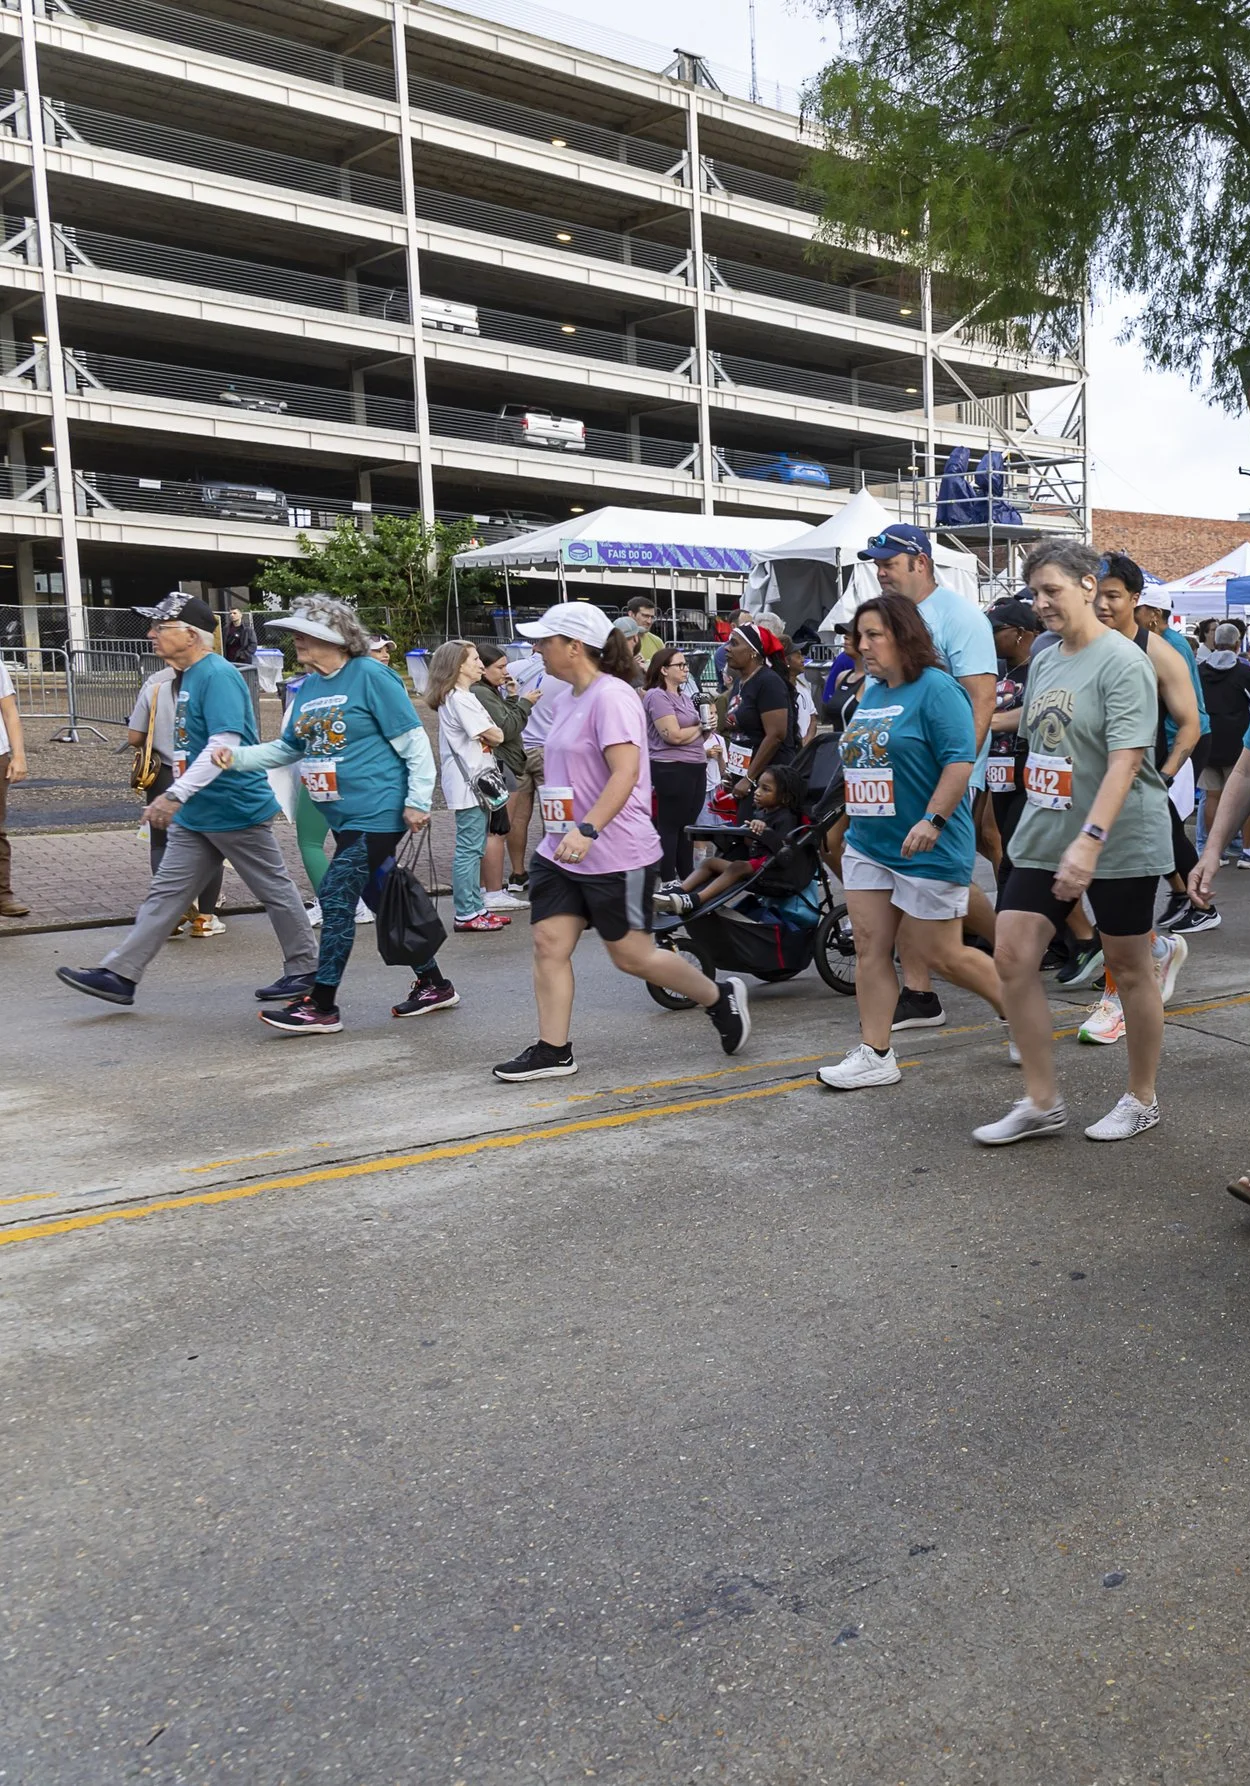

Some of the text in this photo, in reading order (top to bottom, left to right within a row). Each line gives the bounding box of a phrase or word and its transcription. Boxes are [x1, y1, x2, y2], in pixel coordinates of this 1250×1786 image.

[608, 550, 653, 560] FAIS DO DO
[847, 781, 891, 803] 1000
[1028, 768, 1060, 794] 442
